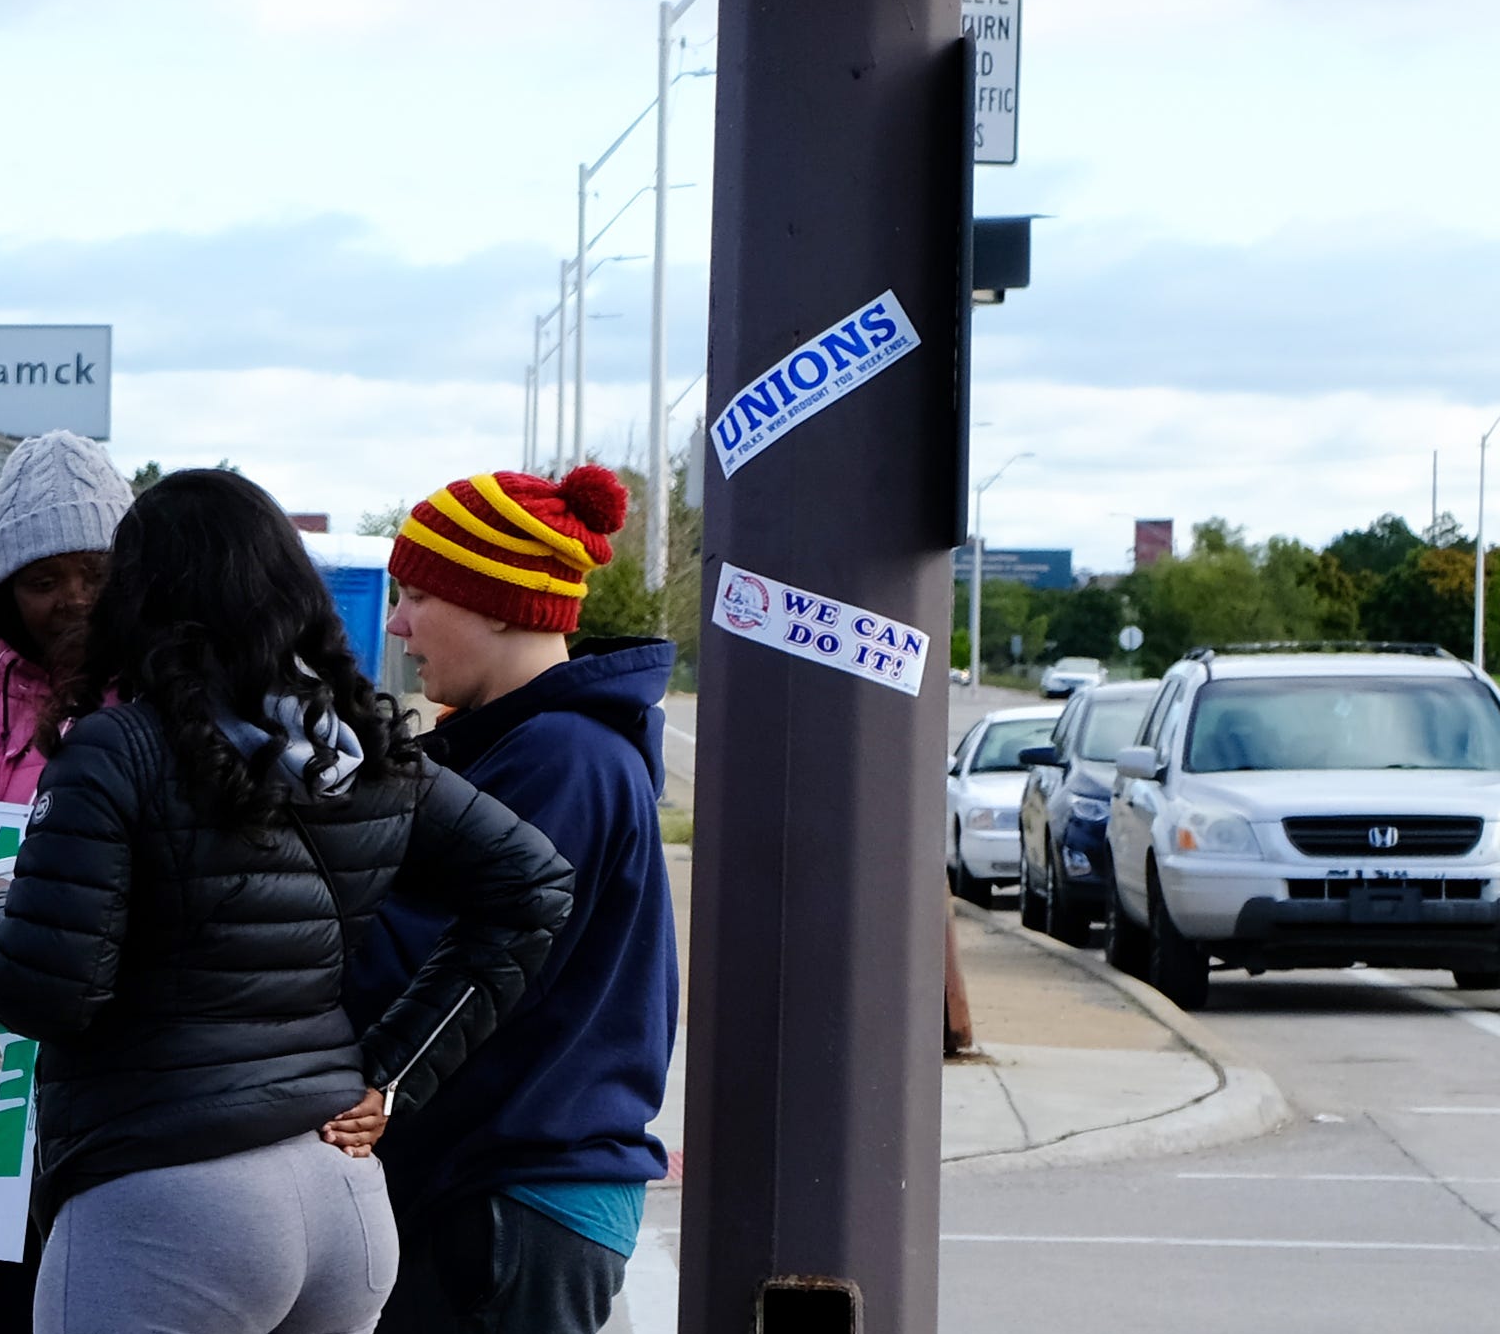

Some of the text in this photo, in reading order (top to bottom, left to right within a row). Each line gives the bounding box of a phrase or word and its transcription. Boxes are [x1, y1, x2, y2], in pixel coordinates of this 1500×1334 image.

[976, 87, 1014, 113] FFIC
[716, 302, 897, 452] UNIONS
[737, 433, 765, 457] FOLKS
[766, 414, 788, 434] WHO
[787, 386, 831, 420] BROUGHT
[833, 371, 855, 389] YOU
[783, 590, 840, 627] WE
[852, 615, 924, 657] CAN
[785, 621, 906, 679] DO IT!
